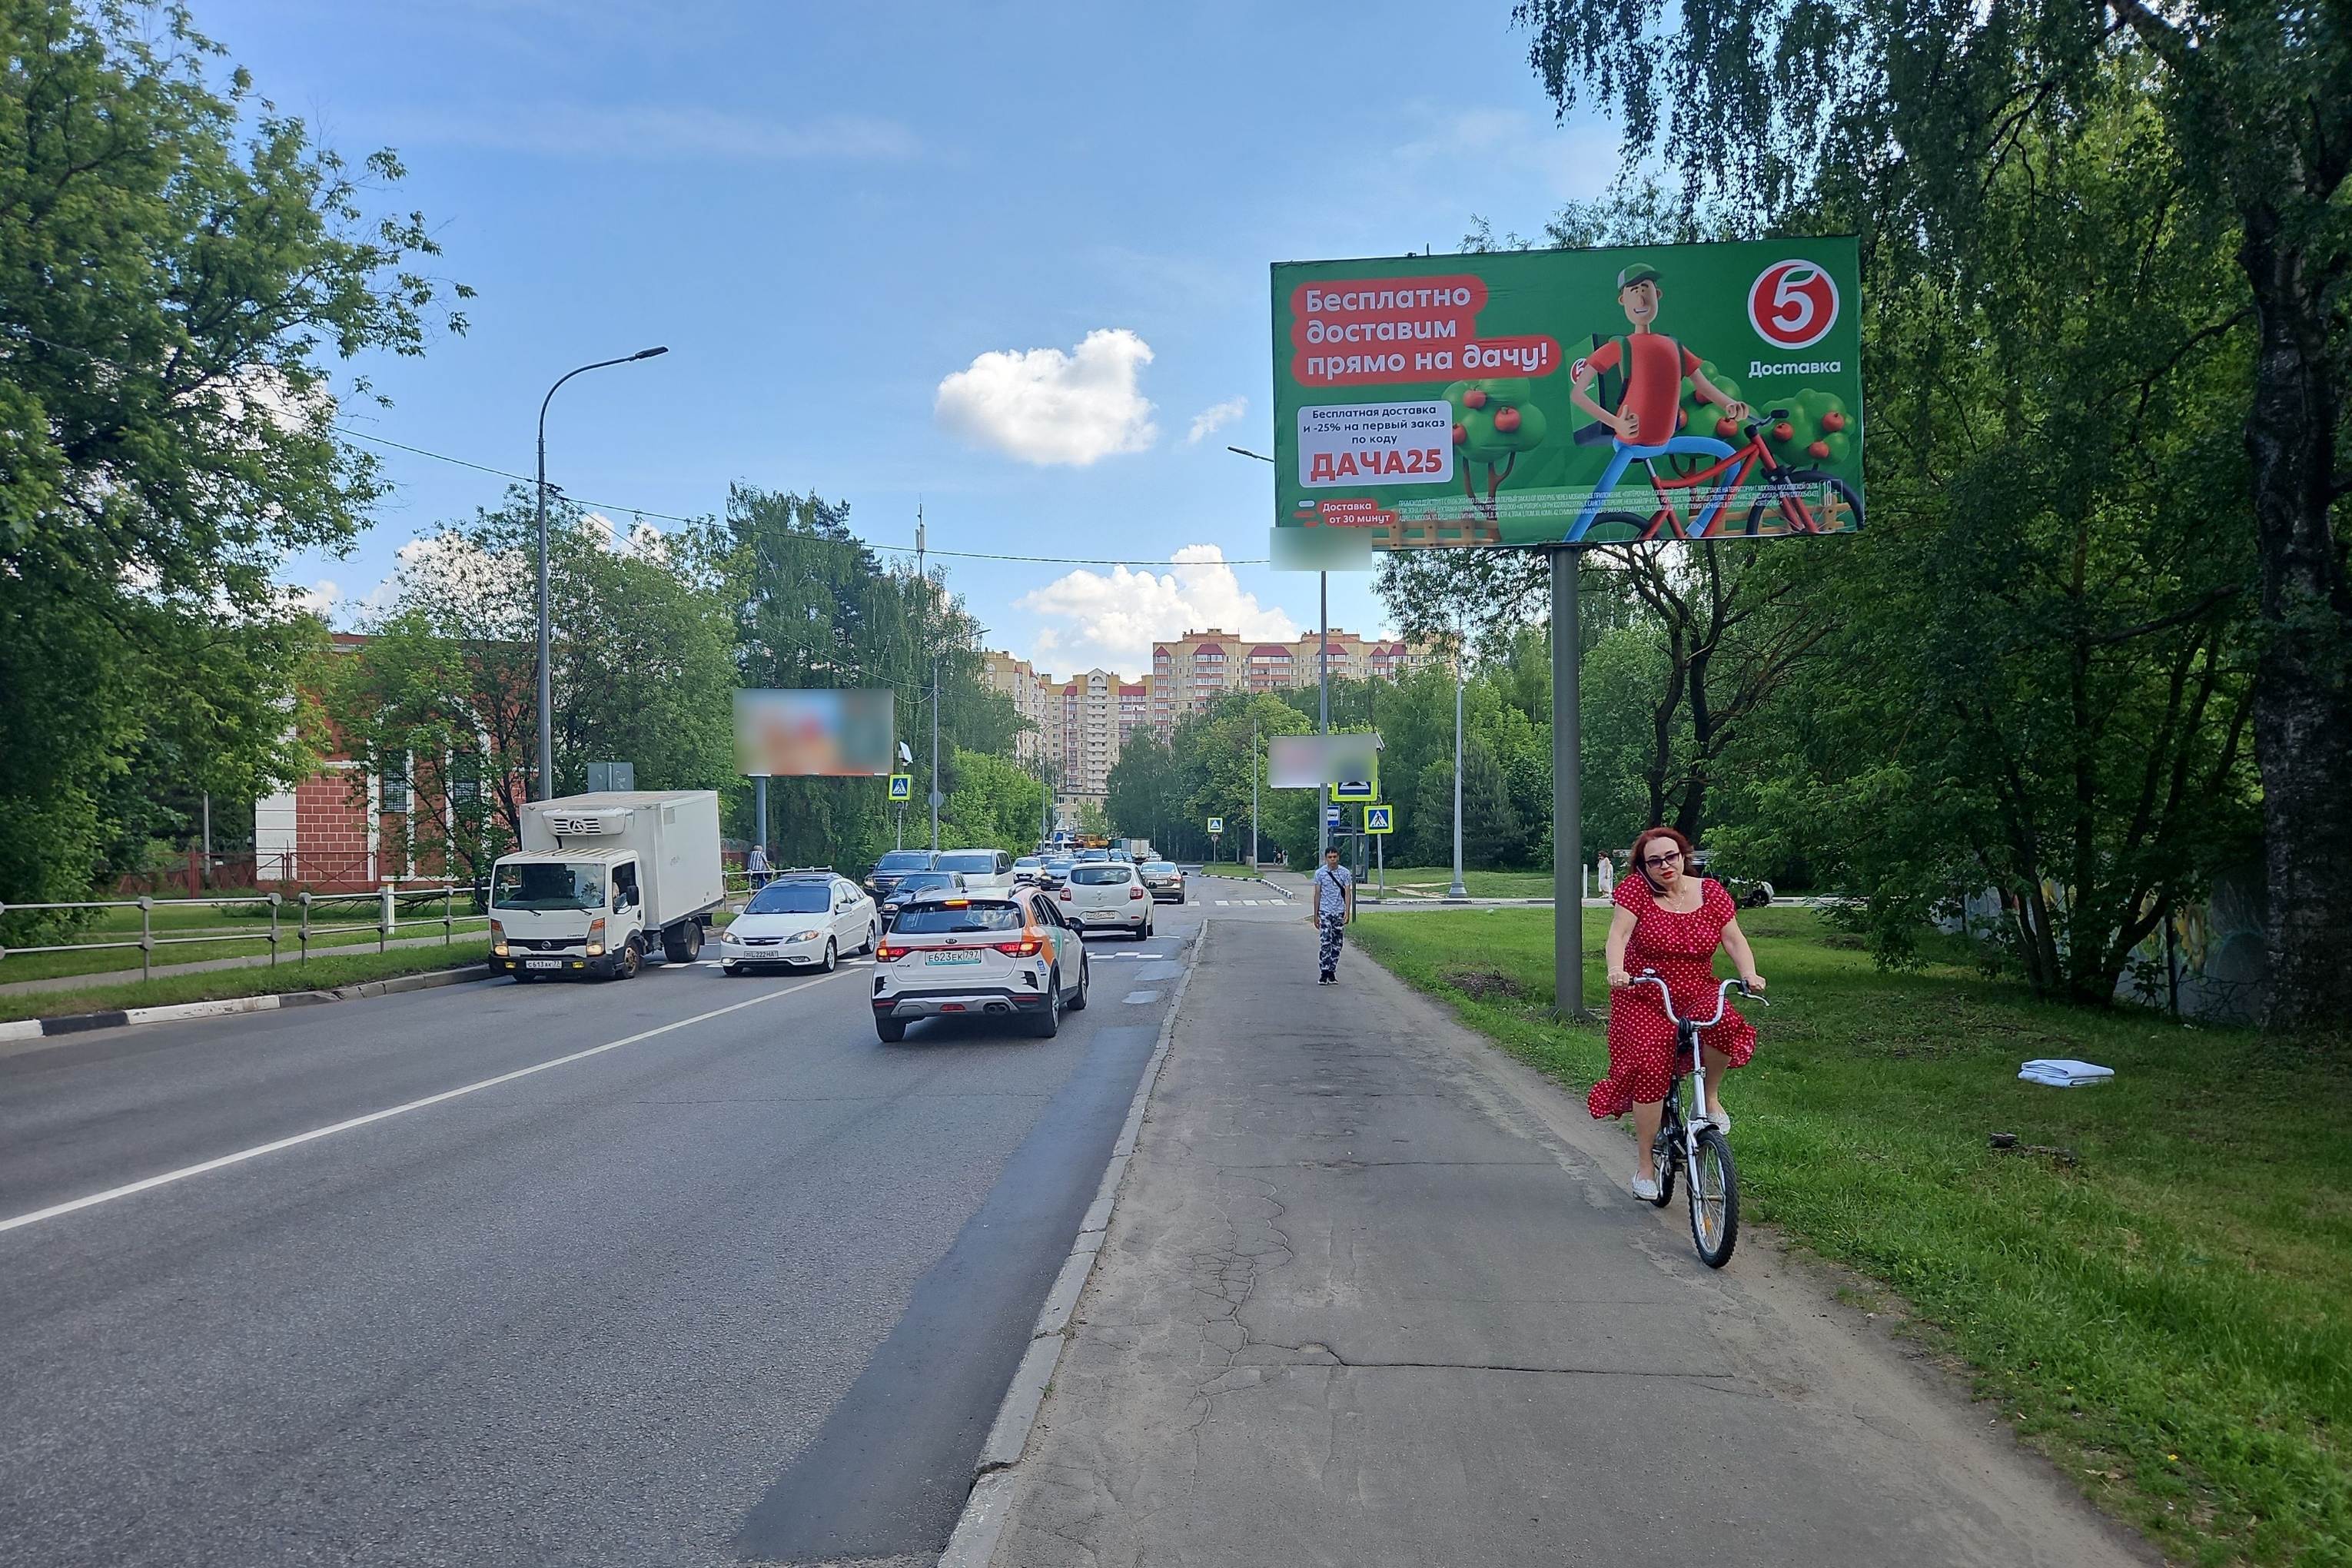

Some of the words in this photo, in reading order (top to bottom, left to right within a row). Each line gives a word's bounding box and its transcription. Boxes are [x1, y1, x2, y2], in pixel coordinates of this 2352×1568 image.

[1306, 287, 1470, 312] Бесплатно
[1306, 319, 1457, 344] доставим
[1307, 354, 1406, 380] прямо
[1415, 350, 1453, 371] на
[1462, 342, 1548, 372] дачу!
[1748, 360, 1842, 378] Доставка
[1312, 409, 1380, 419] Бесплатная
[1382, 406, 1437, 417] доставка
[1314, 422, 1341, 433] -25%
[1344, 423, 1359, 431] на
[1362, 419, 1408, 432] первый
[1410, 418, 1445, 428] заказ
[1351, 436, 1367, 444] по
[1370, 435, 1398, 445] коду
[1310, 448, 1443, 482] ДАЧА25
[1322, 502, 1372, 513] Доставка
[1329, 516, 1342, 524] от
[1343, 514, 1357, 523] 30
[1357, 513, 1390, 524] минут
[928, 952, 963, 962] Е623ЕК
